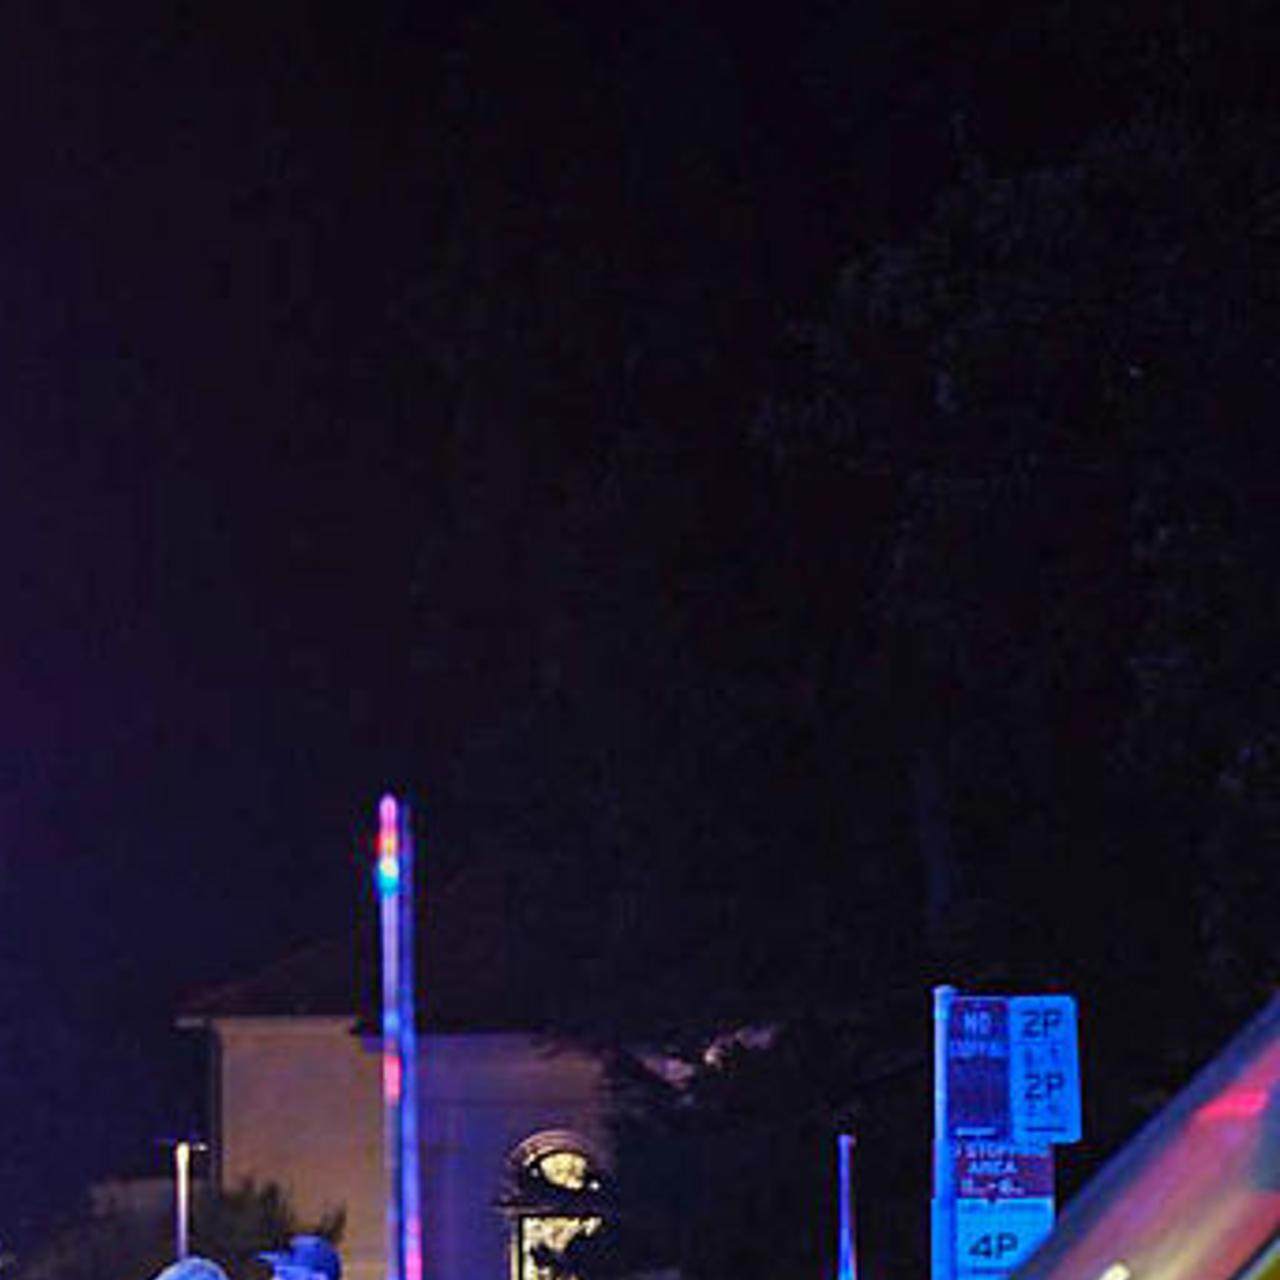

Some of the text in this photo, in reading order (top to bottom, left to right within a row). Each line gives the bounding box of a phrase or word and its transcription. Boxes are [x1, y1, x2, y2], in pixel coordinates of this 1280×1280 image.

[1022, 1009, 1064, 1039] 2P
[1024, 1073, 1065, 1101] 2P
[968, 1231, 1019, 1259] 4P
